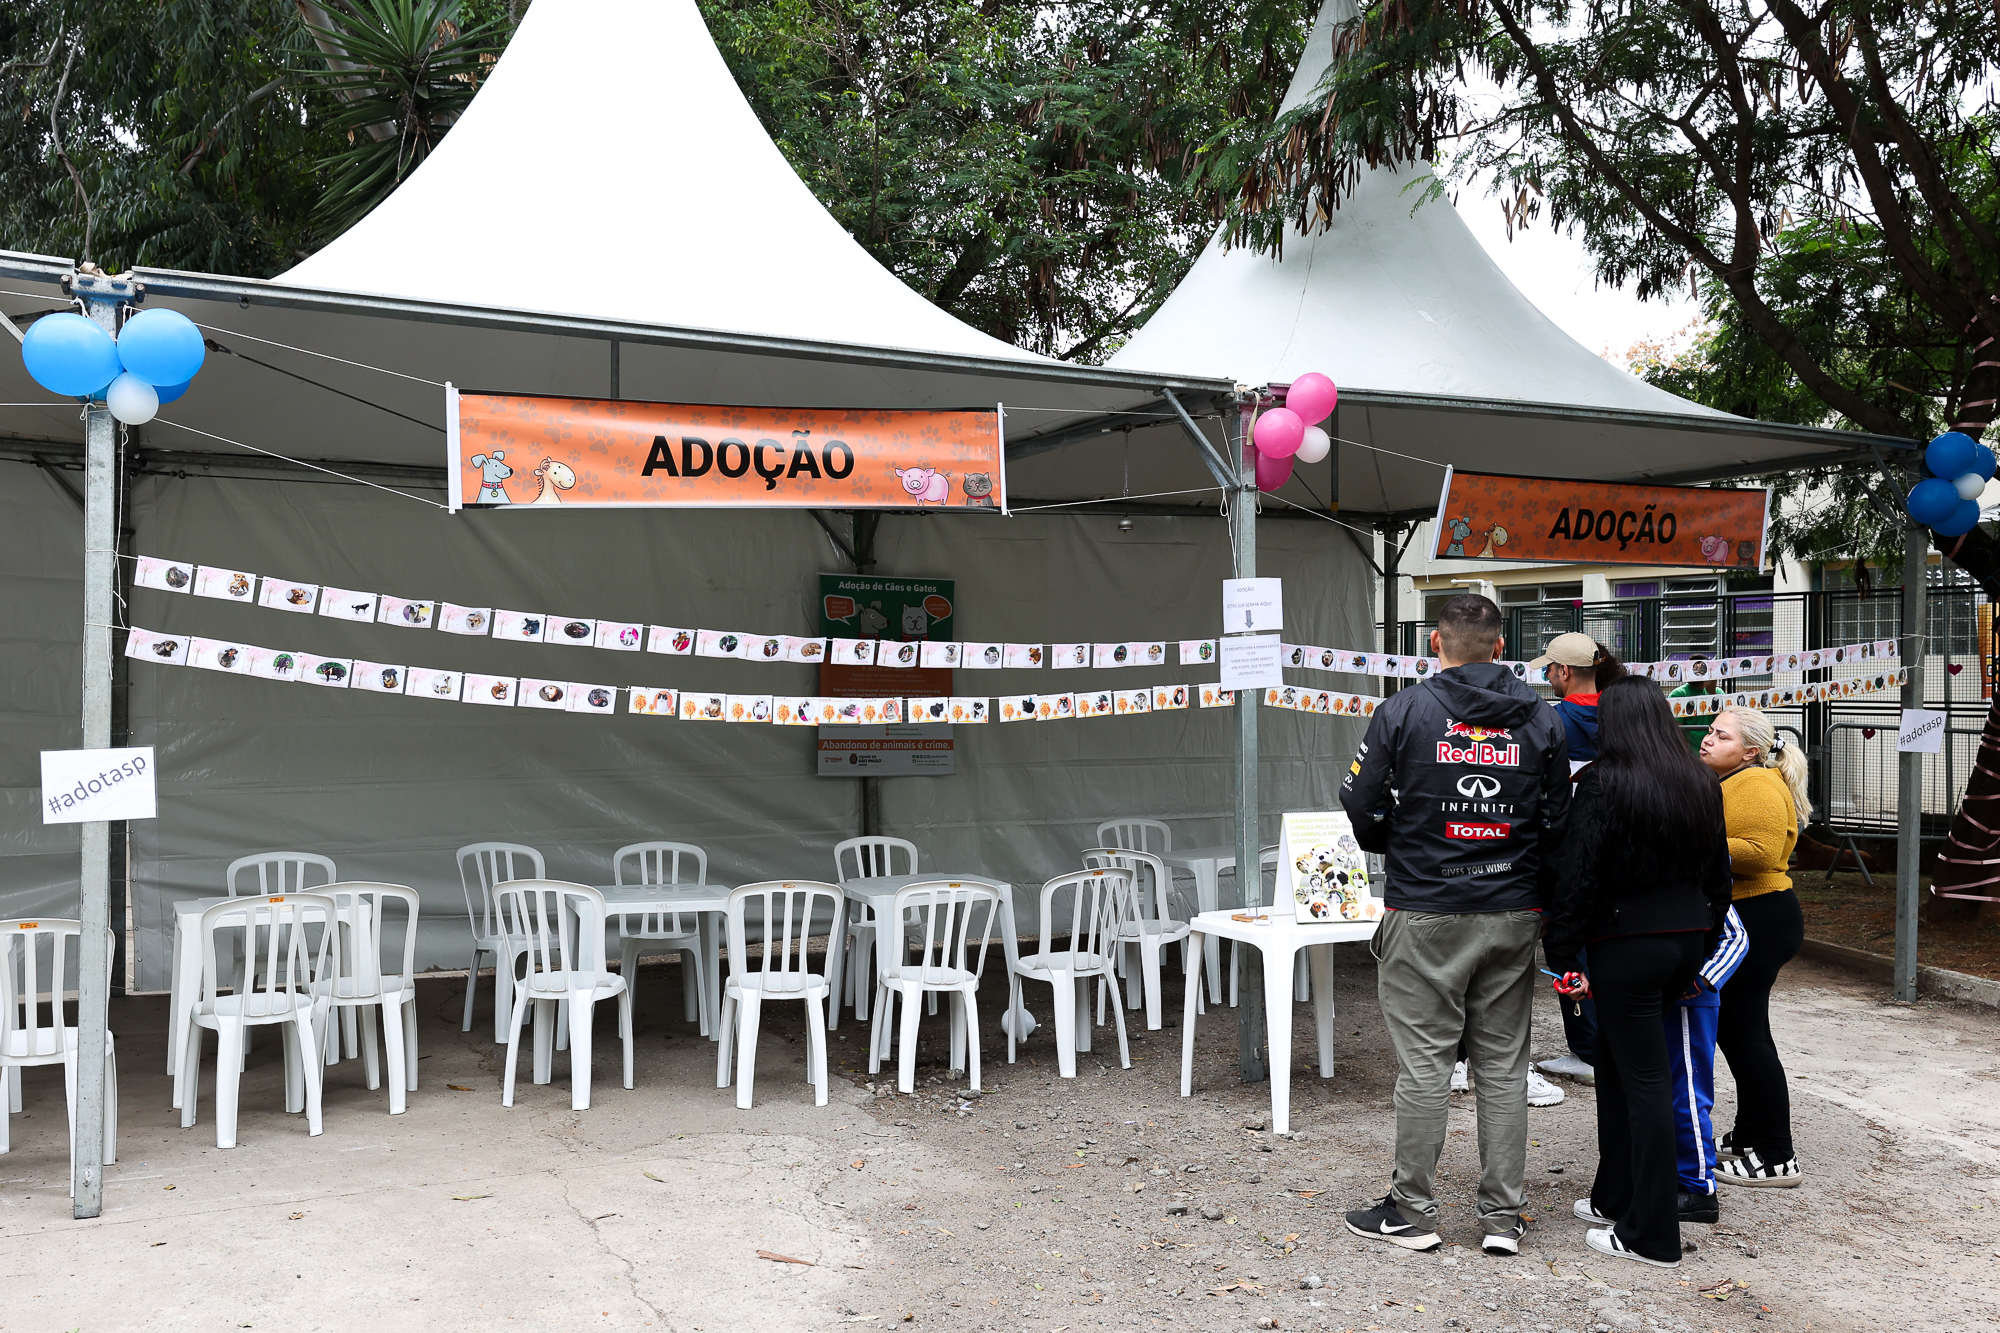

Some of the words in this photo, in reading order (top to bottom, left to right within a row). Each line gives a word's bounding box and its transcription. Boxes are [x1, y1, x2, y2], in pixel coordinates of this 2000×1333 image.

[641, 430, 854, 490] ADOÇÃO
[1548, 504, 1676, 551] ADOÇÃO
[839, 581, 870, 591] Adoção
[872, 582, 883, 590] de
[885, 583, 904, 591] Cães
[914, 584, 937, 592] Gatos
[1900, 716, 1942, 746] #adotasp
[822, 741, 868, 749] Abandono
[870, 741, 880, 749] de
[883, 741, 916, 749] animais
[918, 741, 923, 749] é
[925, 741, 950, 749] crime.
[1437, 741, 1478, 764] Red
[1480, 743, 1520, 766] Bull
[48, 757, 146, 814] #adotasp
[1442, 802, 1513, 814] INFINITI
[1450, 824, 1506, 837] TOTAL
[1442, 867, 1464, 876] GIVES
[1466, 866, 1483, 875] YOU
[1485, 863, 1512, 873] WINGS
